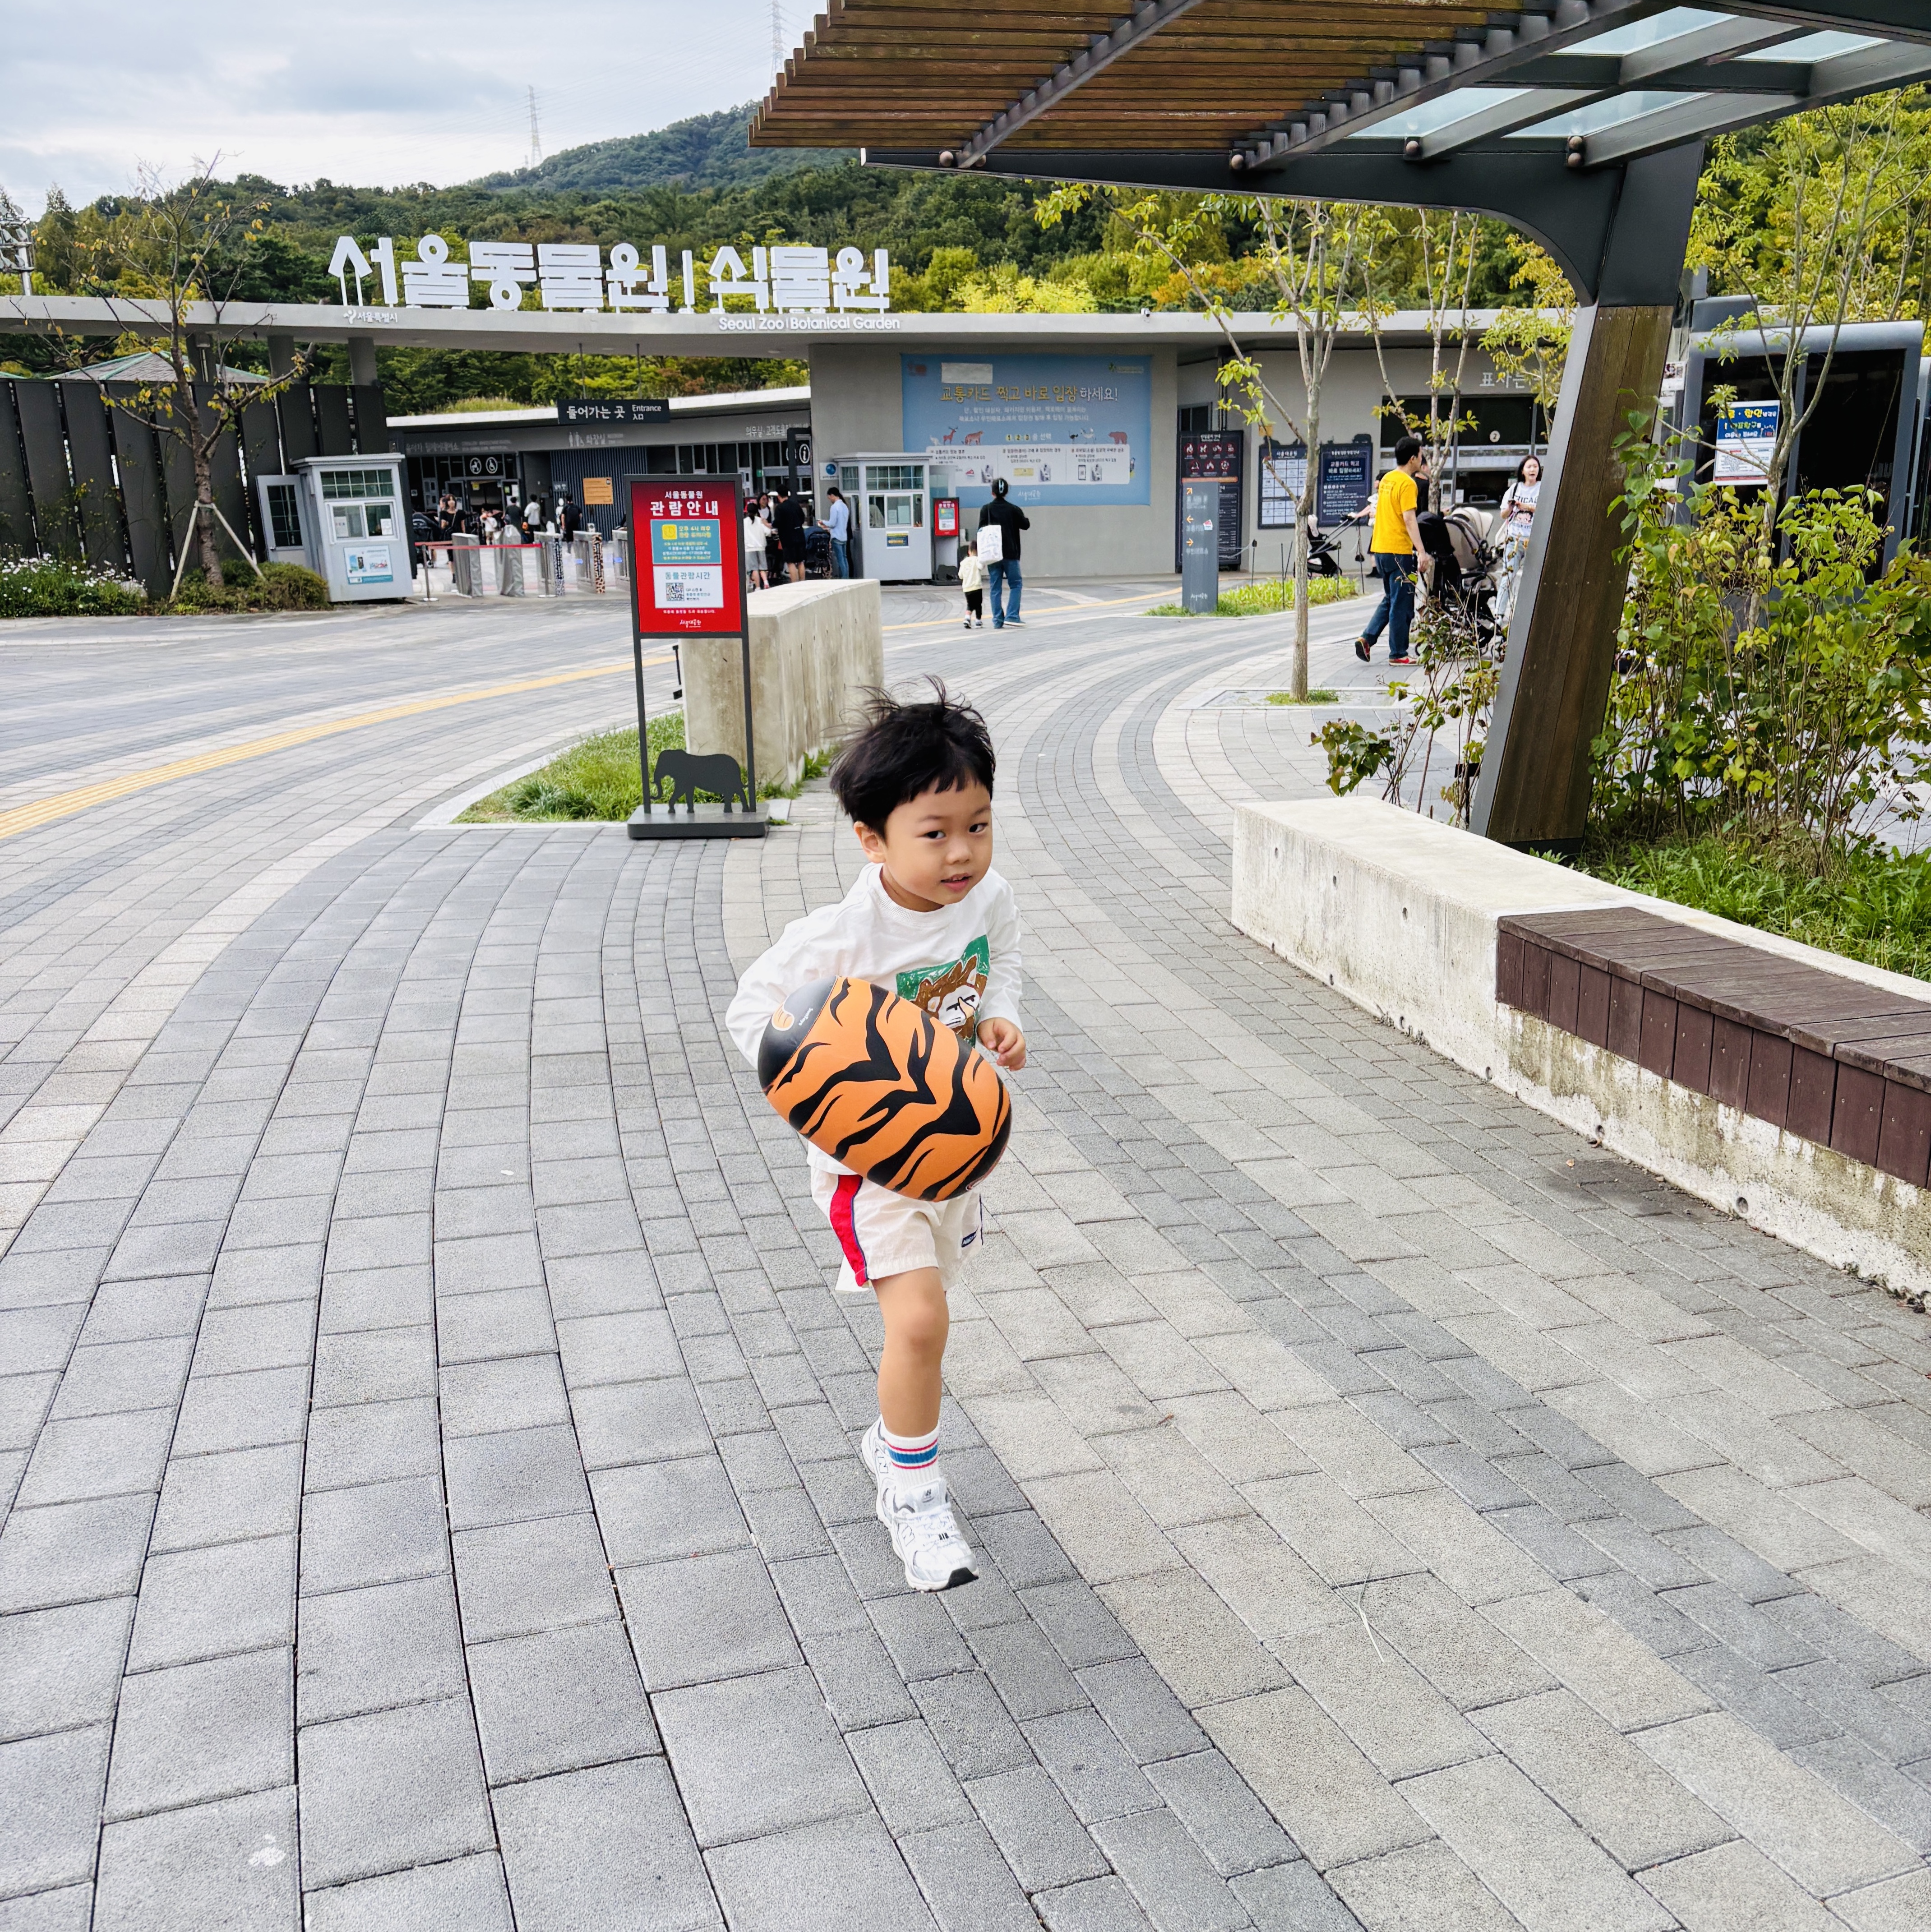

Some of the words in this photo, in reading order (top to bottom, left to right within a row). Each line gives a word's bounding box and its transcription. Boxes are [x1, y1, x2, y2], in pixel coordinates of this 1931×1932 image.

[328, 234, 669, 310] 서울동물원
[709, 246, 890, 309] 식물원
[357, 312, 398, 323] 서울특별시
[719, 317, 755, 330] Seoul
[759, 317, 784, 330] Zoo
[790, 316, 850, 329] Botanical
[853, 317, 900, 330] Garden
[940, 386, 992, 403] 교통카드
[1025, 385, 1050, 401] 바로
[566, 406, 611, 419] 들어가는
[614, 406, 625, 418] 곳
[665, 490, 703, 499] 서울동물원
